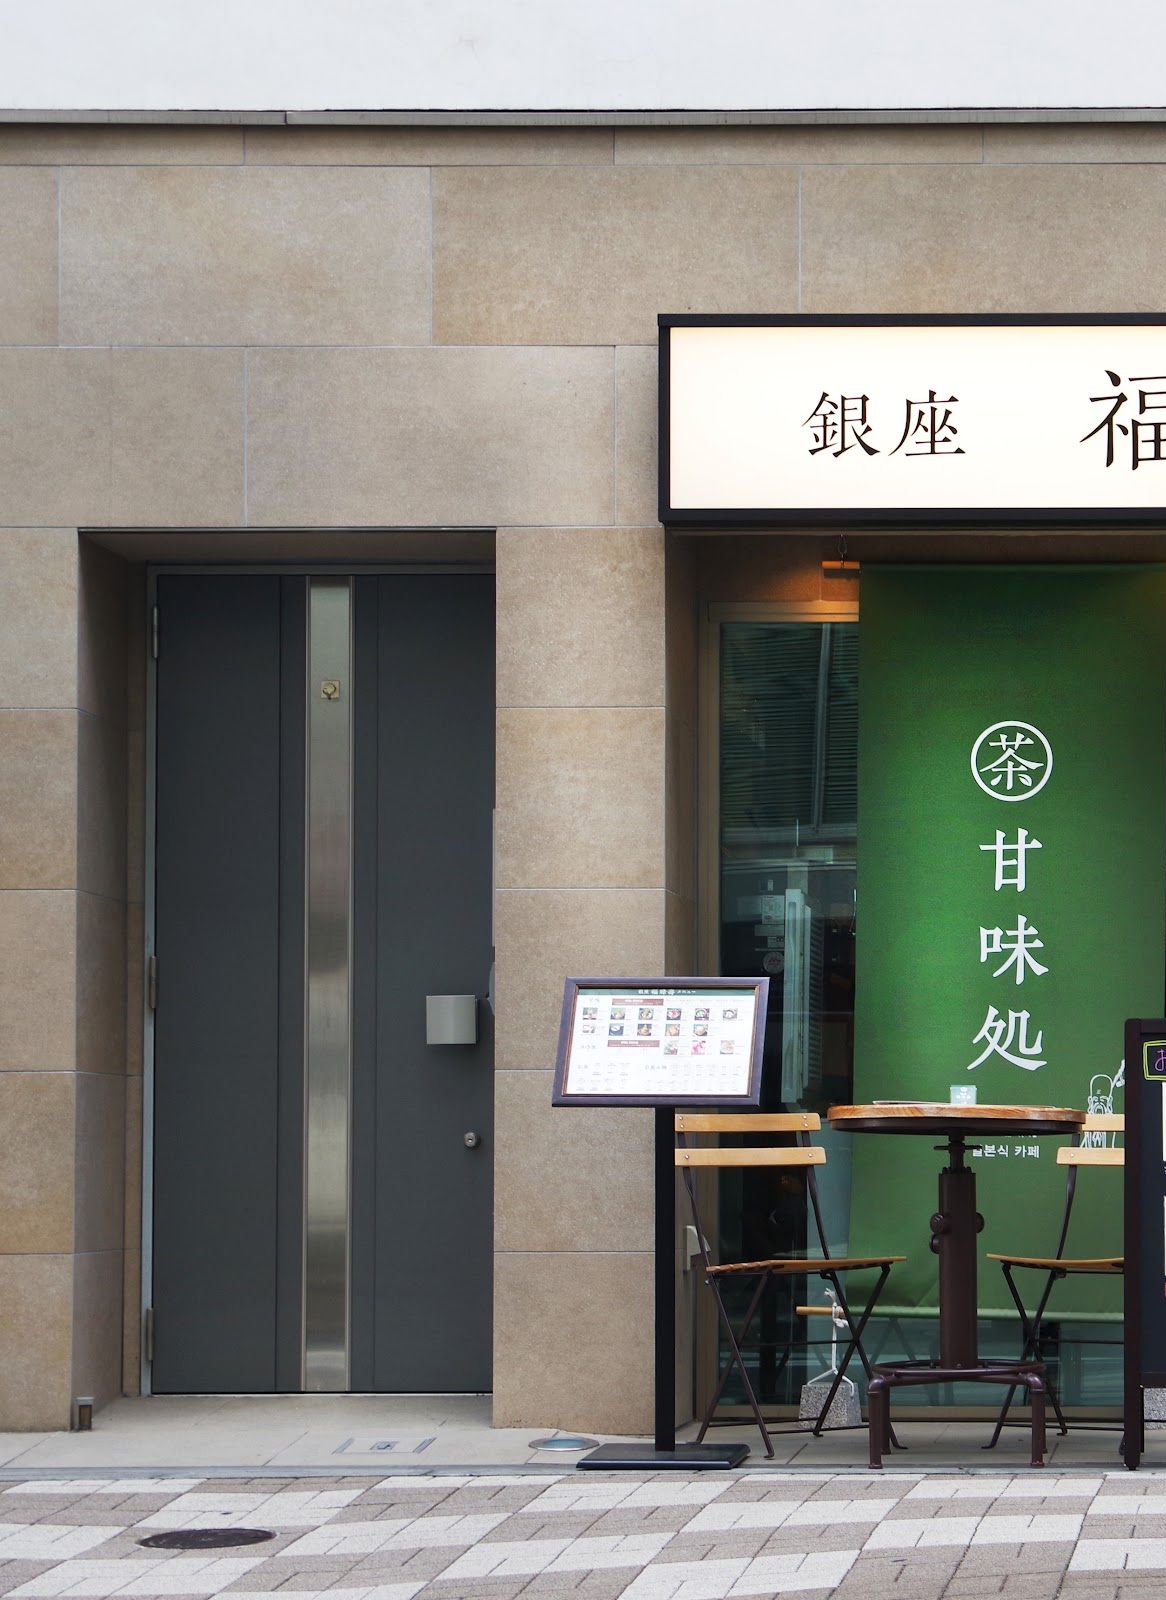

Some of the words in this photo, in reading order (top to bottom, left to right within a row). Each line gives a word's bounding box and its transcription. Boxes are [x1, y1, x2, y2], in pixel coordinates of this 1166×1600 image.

[803, 389, 966, 459] 銀座
[979, 732, 1045, 791] 茶
[966, 827, 1050, 1071] 甘味処
[1014, 1144, 1040, 1159] 카페
